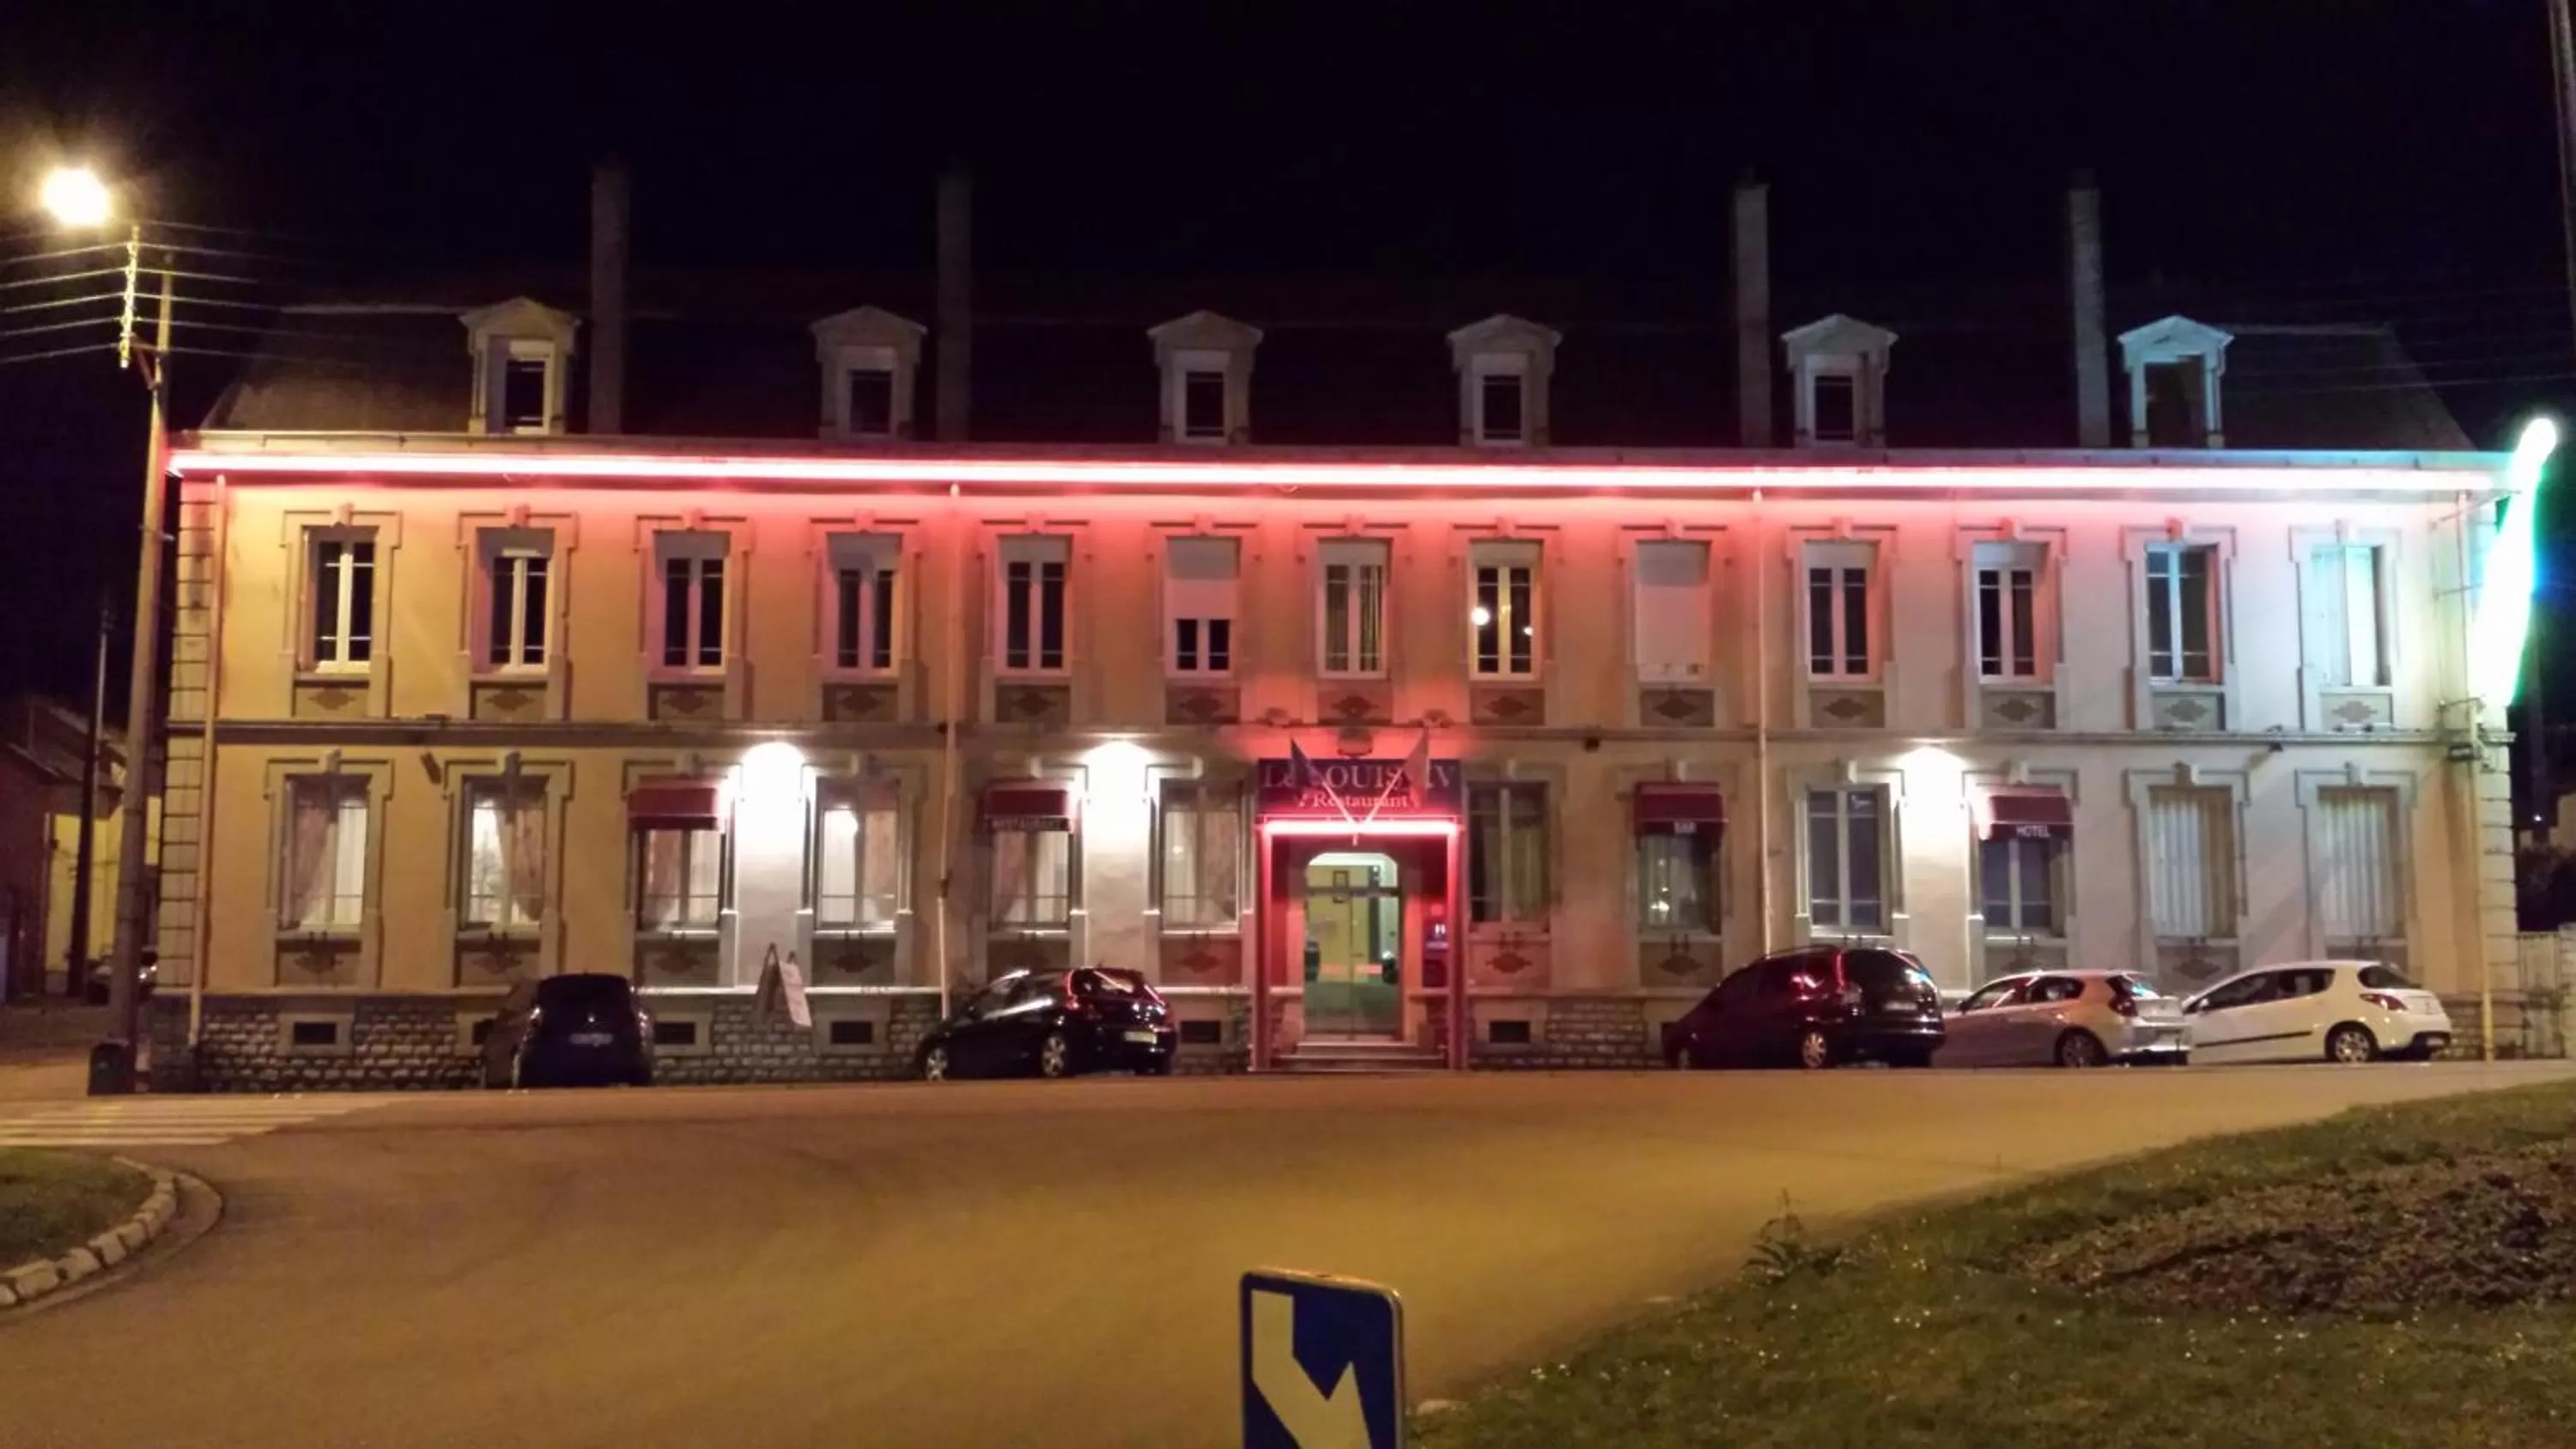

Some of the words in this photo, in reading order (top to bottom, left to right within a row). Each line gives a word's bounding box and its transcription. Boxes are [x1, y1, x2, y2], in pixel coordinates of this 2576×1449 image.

[1321, 764, 1403, 789] OUIS
[1312, 790, 1408, 808] Retaurant
[2016, 824, 2050, 838] HOTEL
